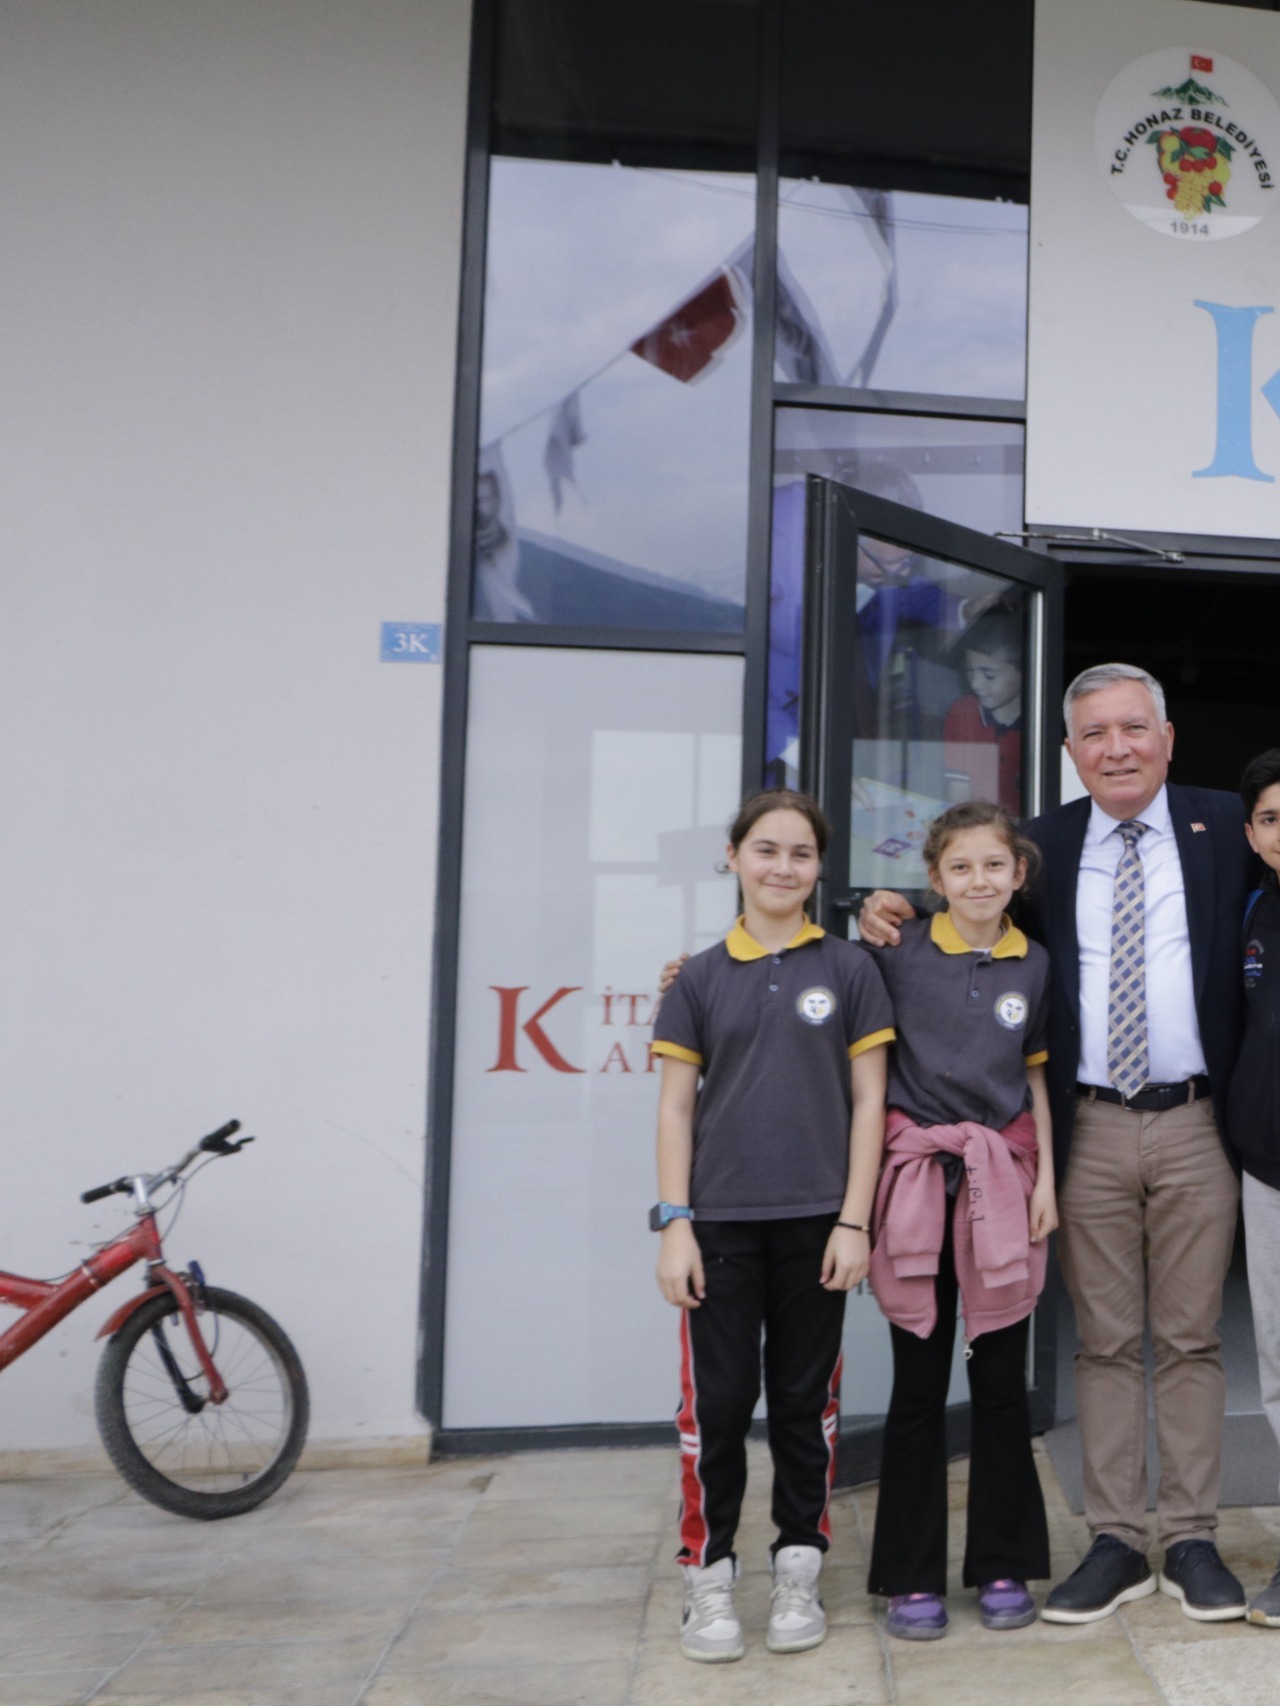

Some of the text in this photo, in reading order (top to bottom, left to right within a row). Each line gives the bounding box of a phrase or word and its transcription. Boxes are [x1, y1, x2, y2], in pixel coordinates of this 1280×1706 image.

[1111, 107, 1275, 190] T.C. HONAZ BELEDİYESİ
[1170, 221, 1210, 236] 1914
[392, 632, 430, 653] 3K
